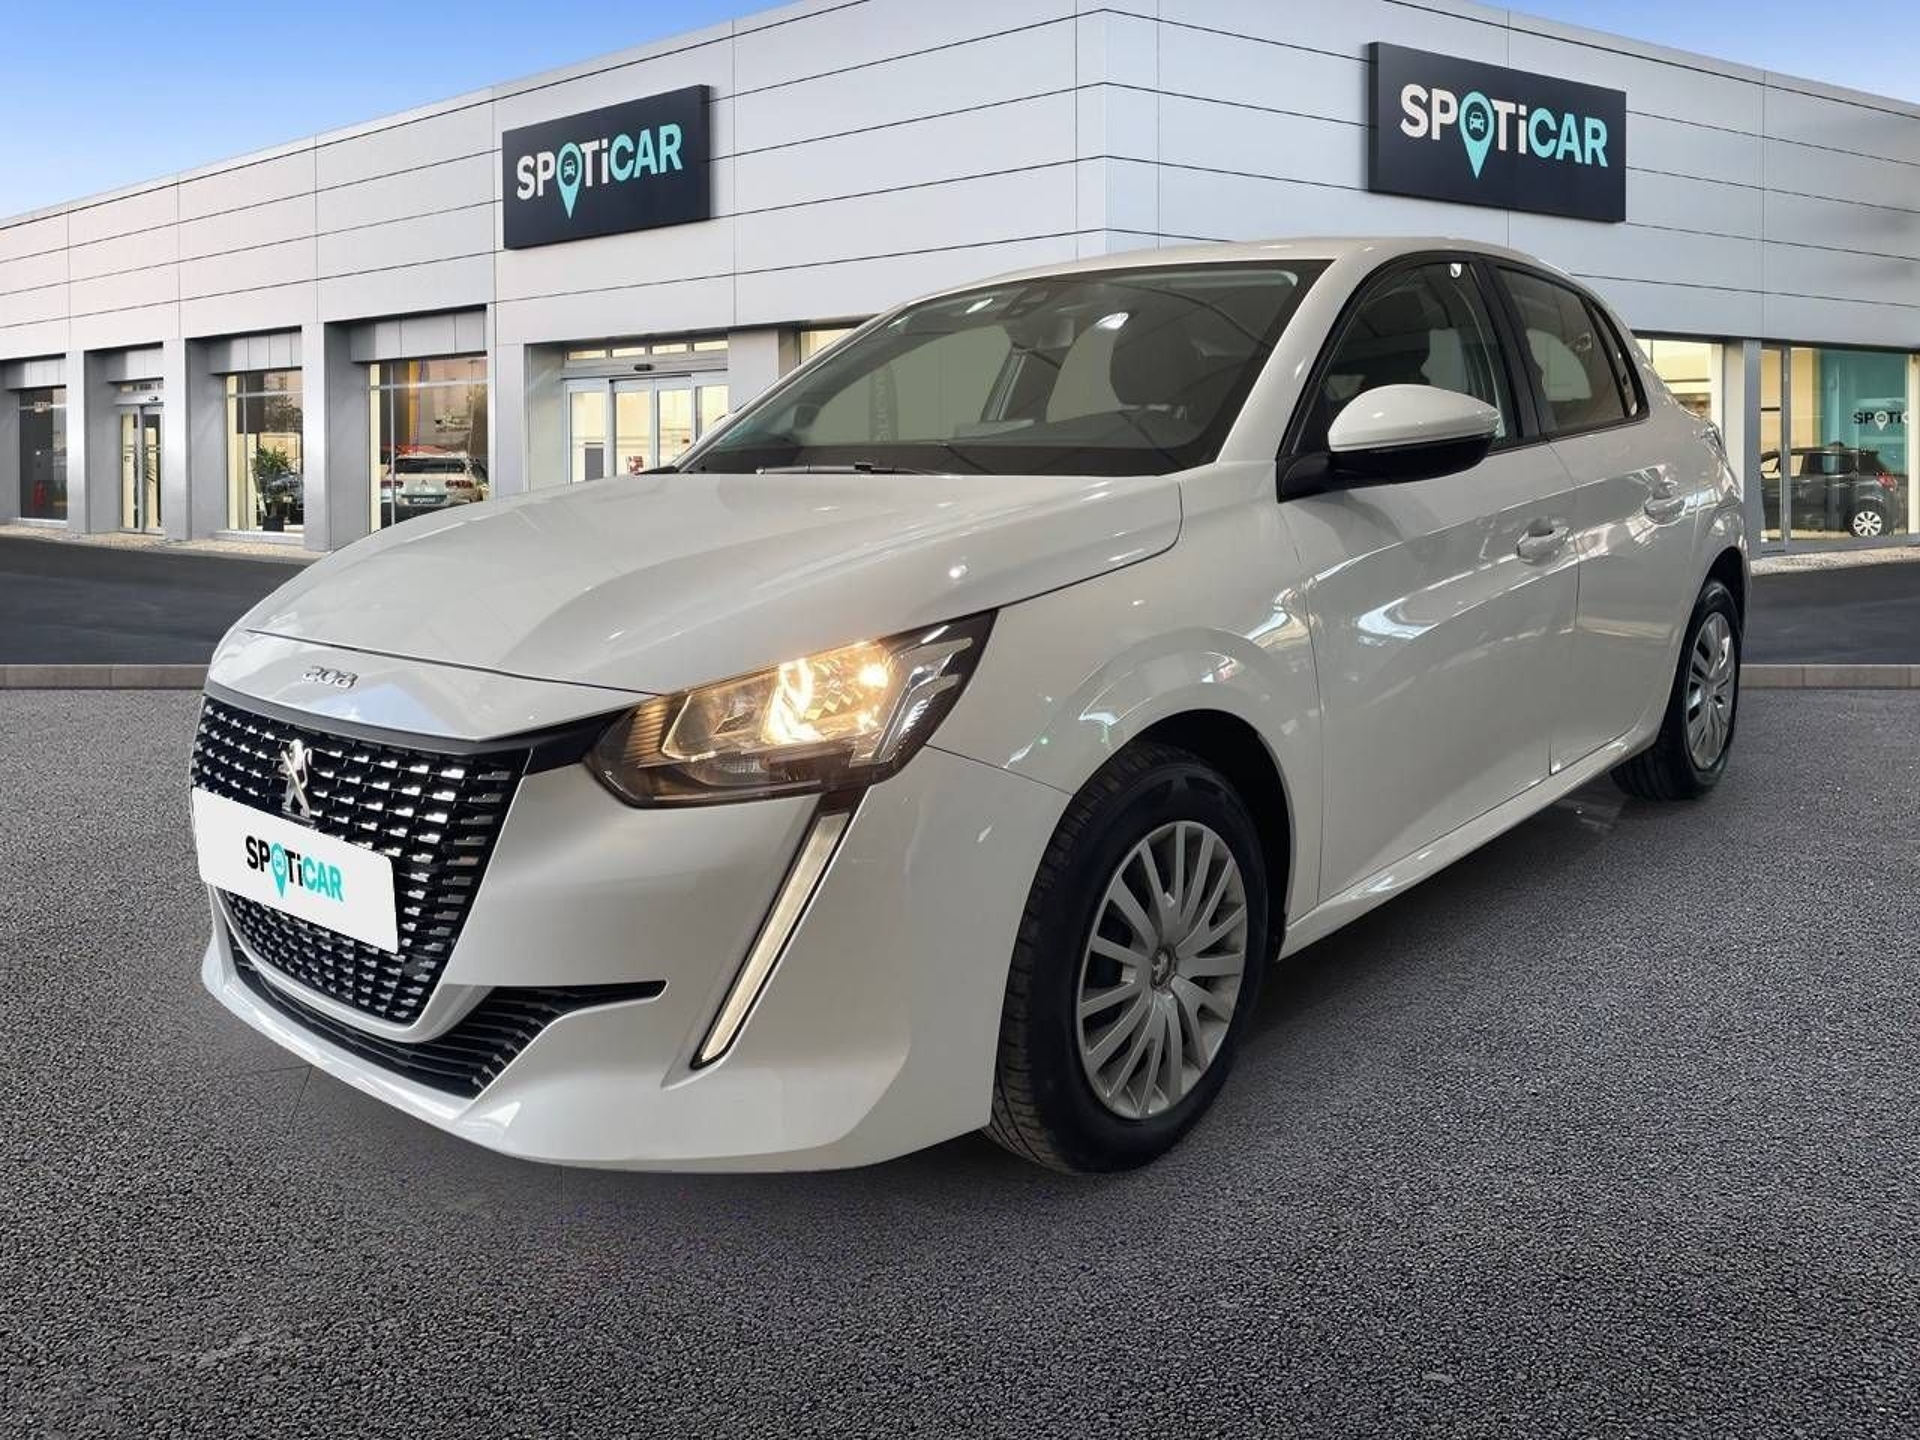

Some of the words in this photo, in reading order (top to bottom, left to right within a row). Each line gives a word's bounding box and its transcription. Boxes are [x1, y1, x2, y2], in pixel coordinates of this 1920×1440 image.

[516, 123, 683, 219] SPOTiCAR
[1400, 83, 1608, 179] SPOTiCAR
[301, 665, 360, 689] 208
[246, 835, 344, 902] SPOTiCAR
